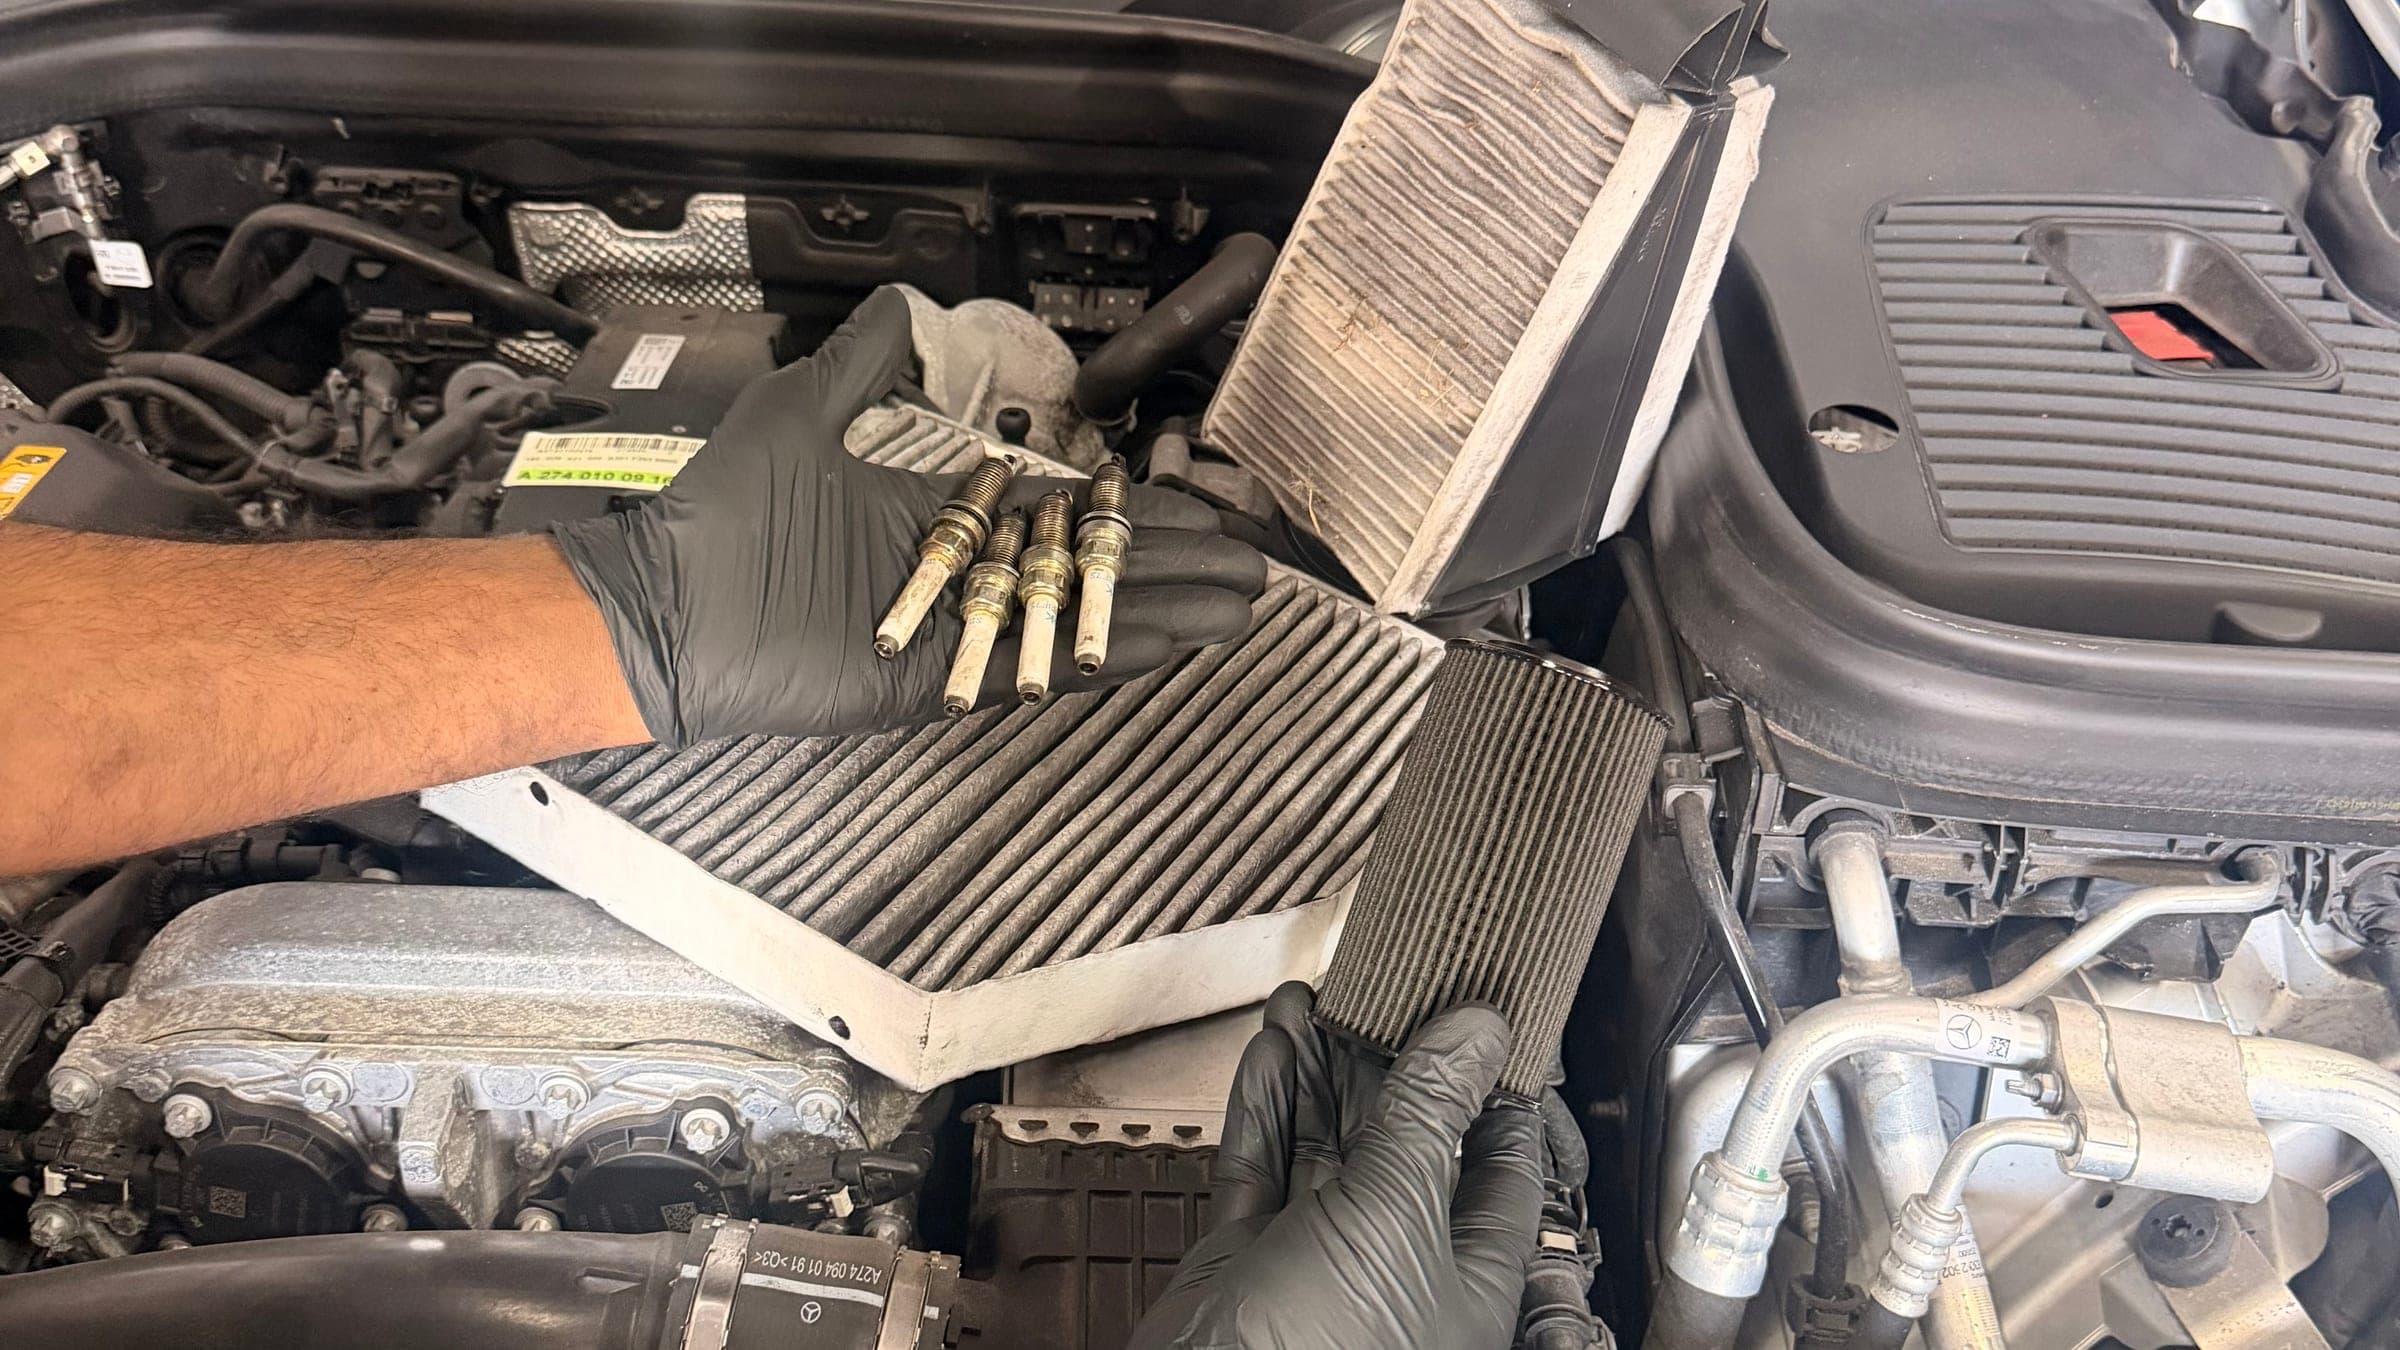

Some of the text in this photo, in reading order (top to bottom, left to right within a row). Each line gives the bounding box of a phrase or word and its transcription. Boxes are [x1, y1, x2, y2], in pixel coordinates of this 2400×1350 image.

[517, 471, 532, 481] A
[538, 471, 572, 481] 274
[580, 472, 615, 482] 010
[621, 473, 645, 483] 09
[791, 1256, 806, 1272] 91
[808, 1259, 822, 1276] 01
[825, 1261, 847, 1279] 094
[849, 1264, 882, 1285] A274
